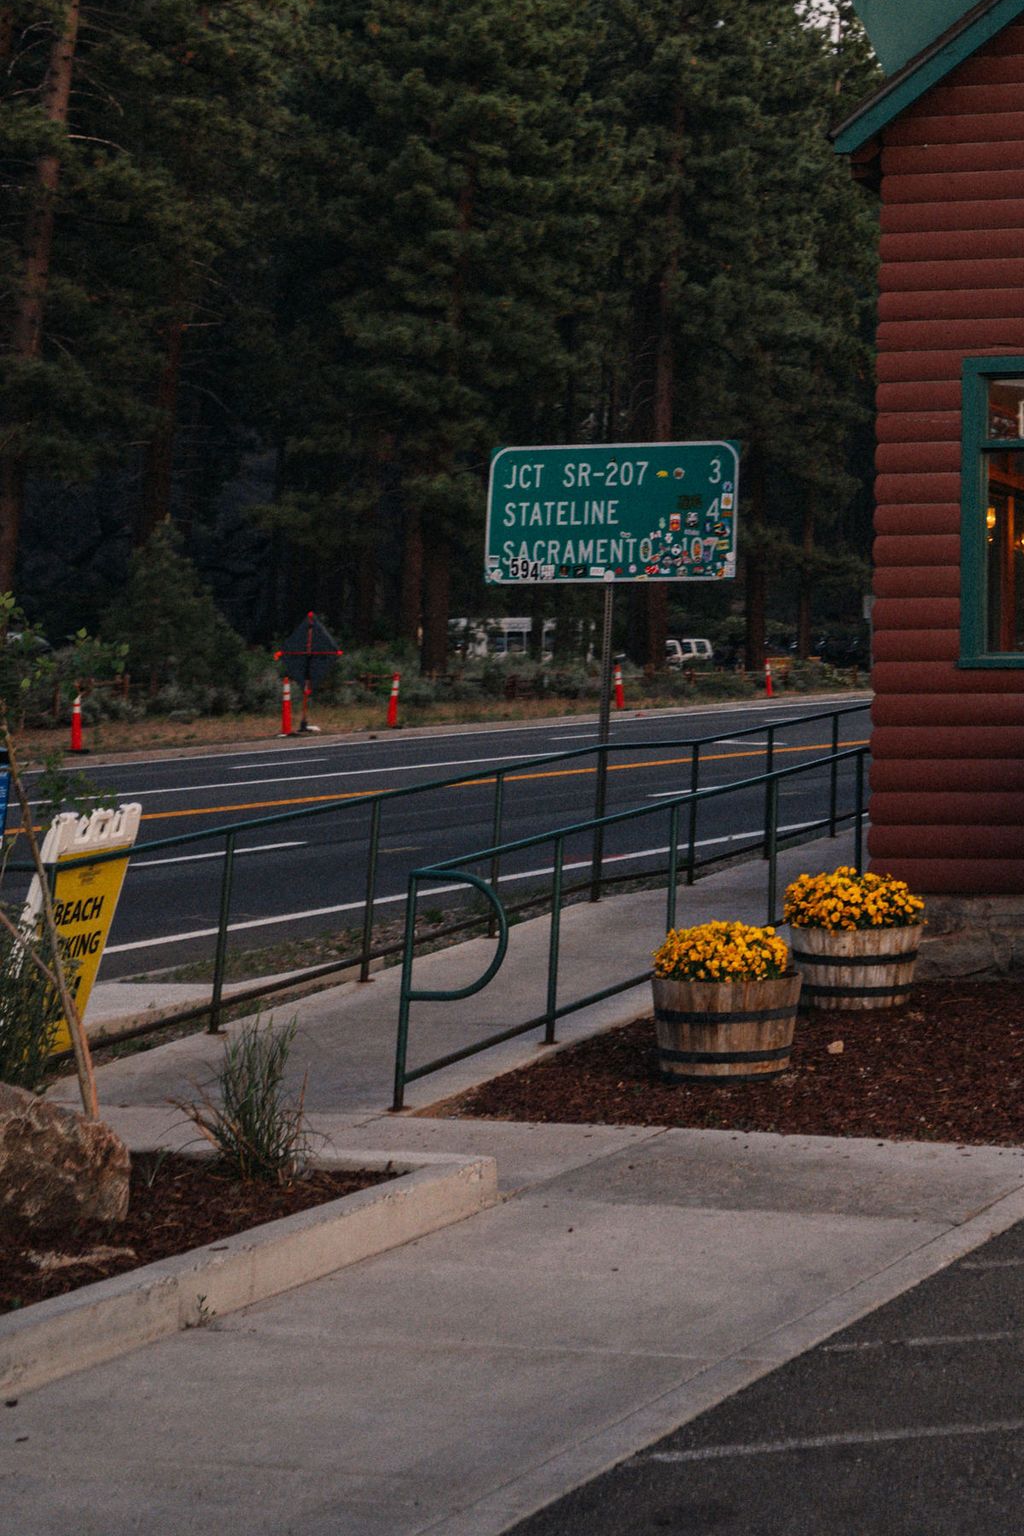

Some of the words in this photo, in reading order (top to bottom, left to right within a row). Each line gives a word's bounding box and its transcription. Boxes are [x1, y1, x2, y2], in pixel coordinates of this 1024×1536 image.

[504, 464, 544, 488] JCT
[563, 462, 649, 487] SR-207
[708, 460, 721, 484] 3
[503, 500, 619, 526] STATELINE
[706, 498, 720, 522] 4
[502, 538, 653, 565] SACRAMENTO
[681, 537, 719, 563] 107
[511, 558, 538, 581] 594
[54, 896, 104, 926] BEACH
